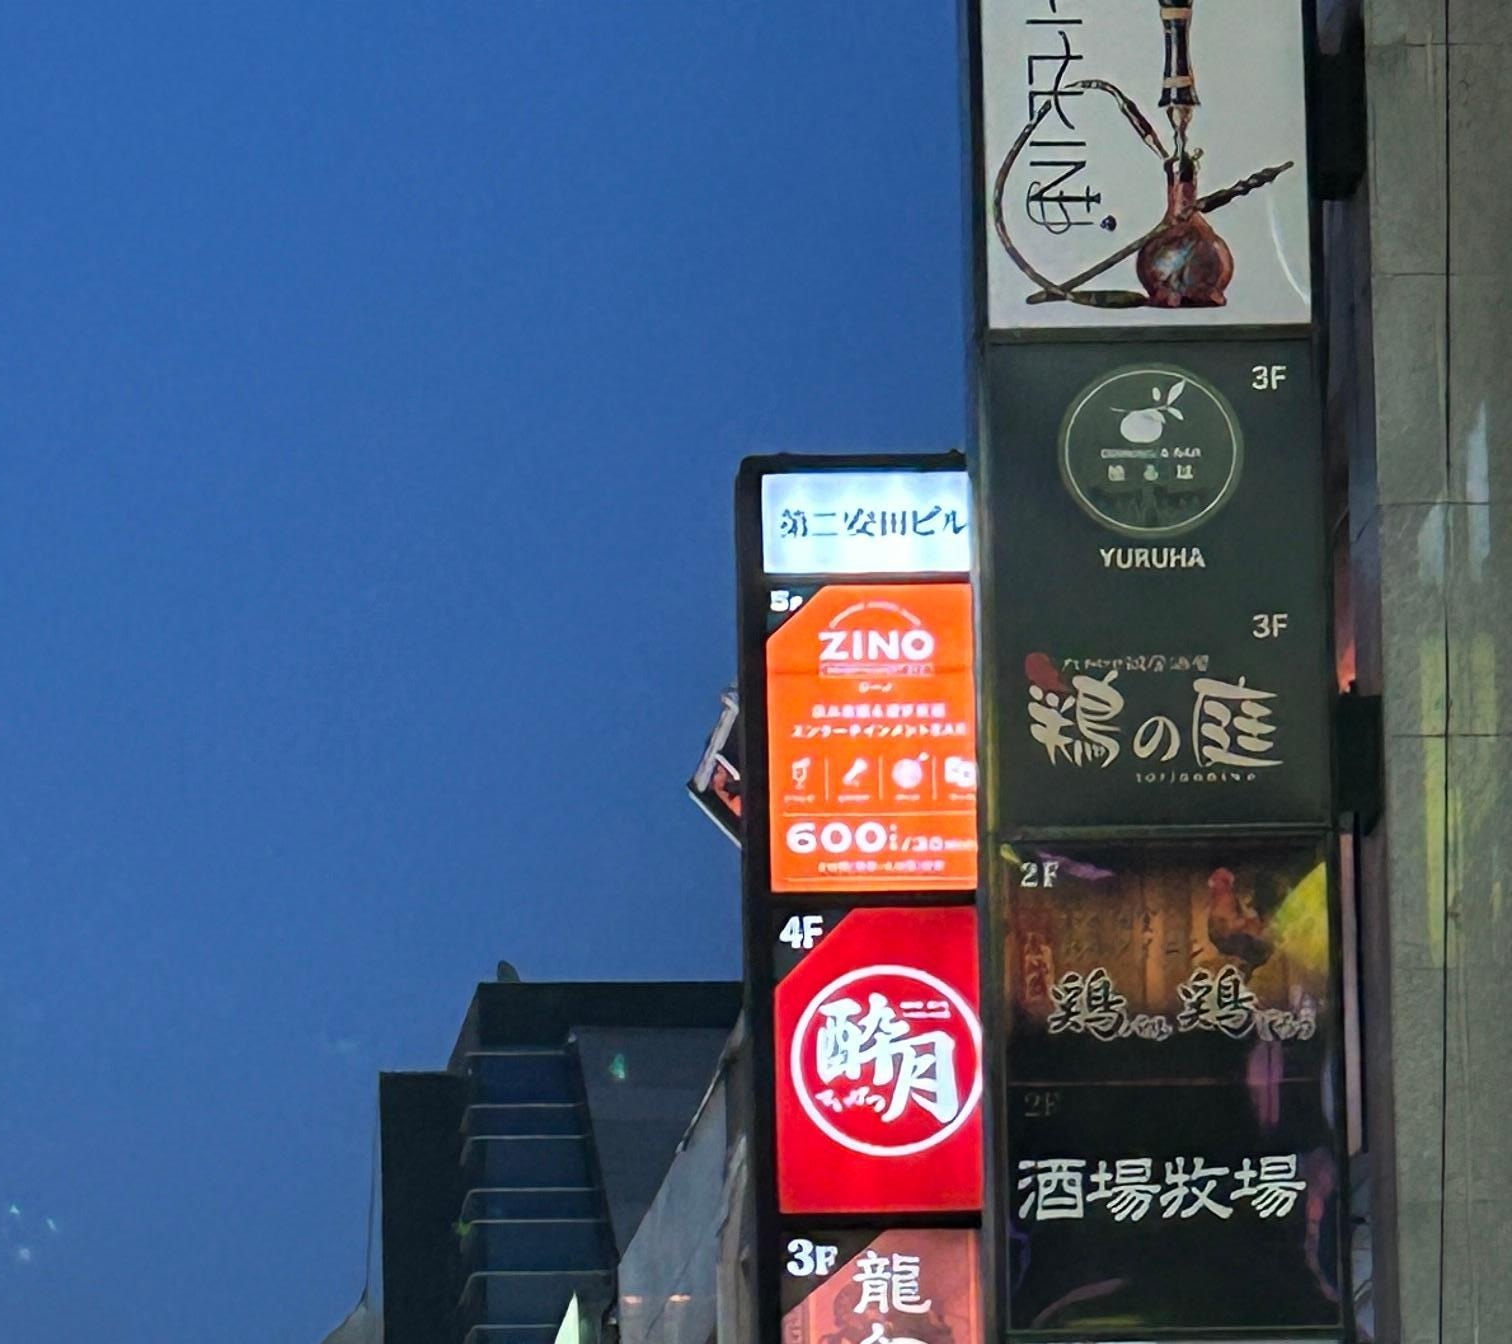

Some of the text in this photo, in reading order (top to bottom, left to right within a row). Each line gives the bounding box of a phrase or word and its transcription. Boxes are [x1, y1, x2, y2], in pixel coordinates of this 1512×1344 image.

[1252, 367, 1287, 391] 3F
[1100, 548, 1206, 569] YURUHA
[1253, 614, 1287, 638] 3F
[819, 630, 934, 661] ZINO
[1028, 668, 1284, 768] 鶏の庭
[1020, 862, 1058, 888] 2F
[780, 916, 823, 949] 4F
[1018, 1153, 1306, 1221] 酒場牧場
[787, 1240, 838, 1277] 3F
